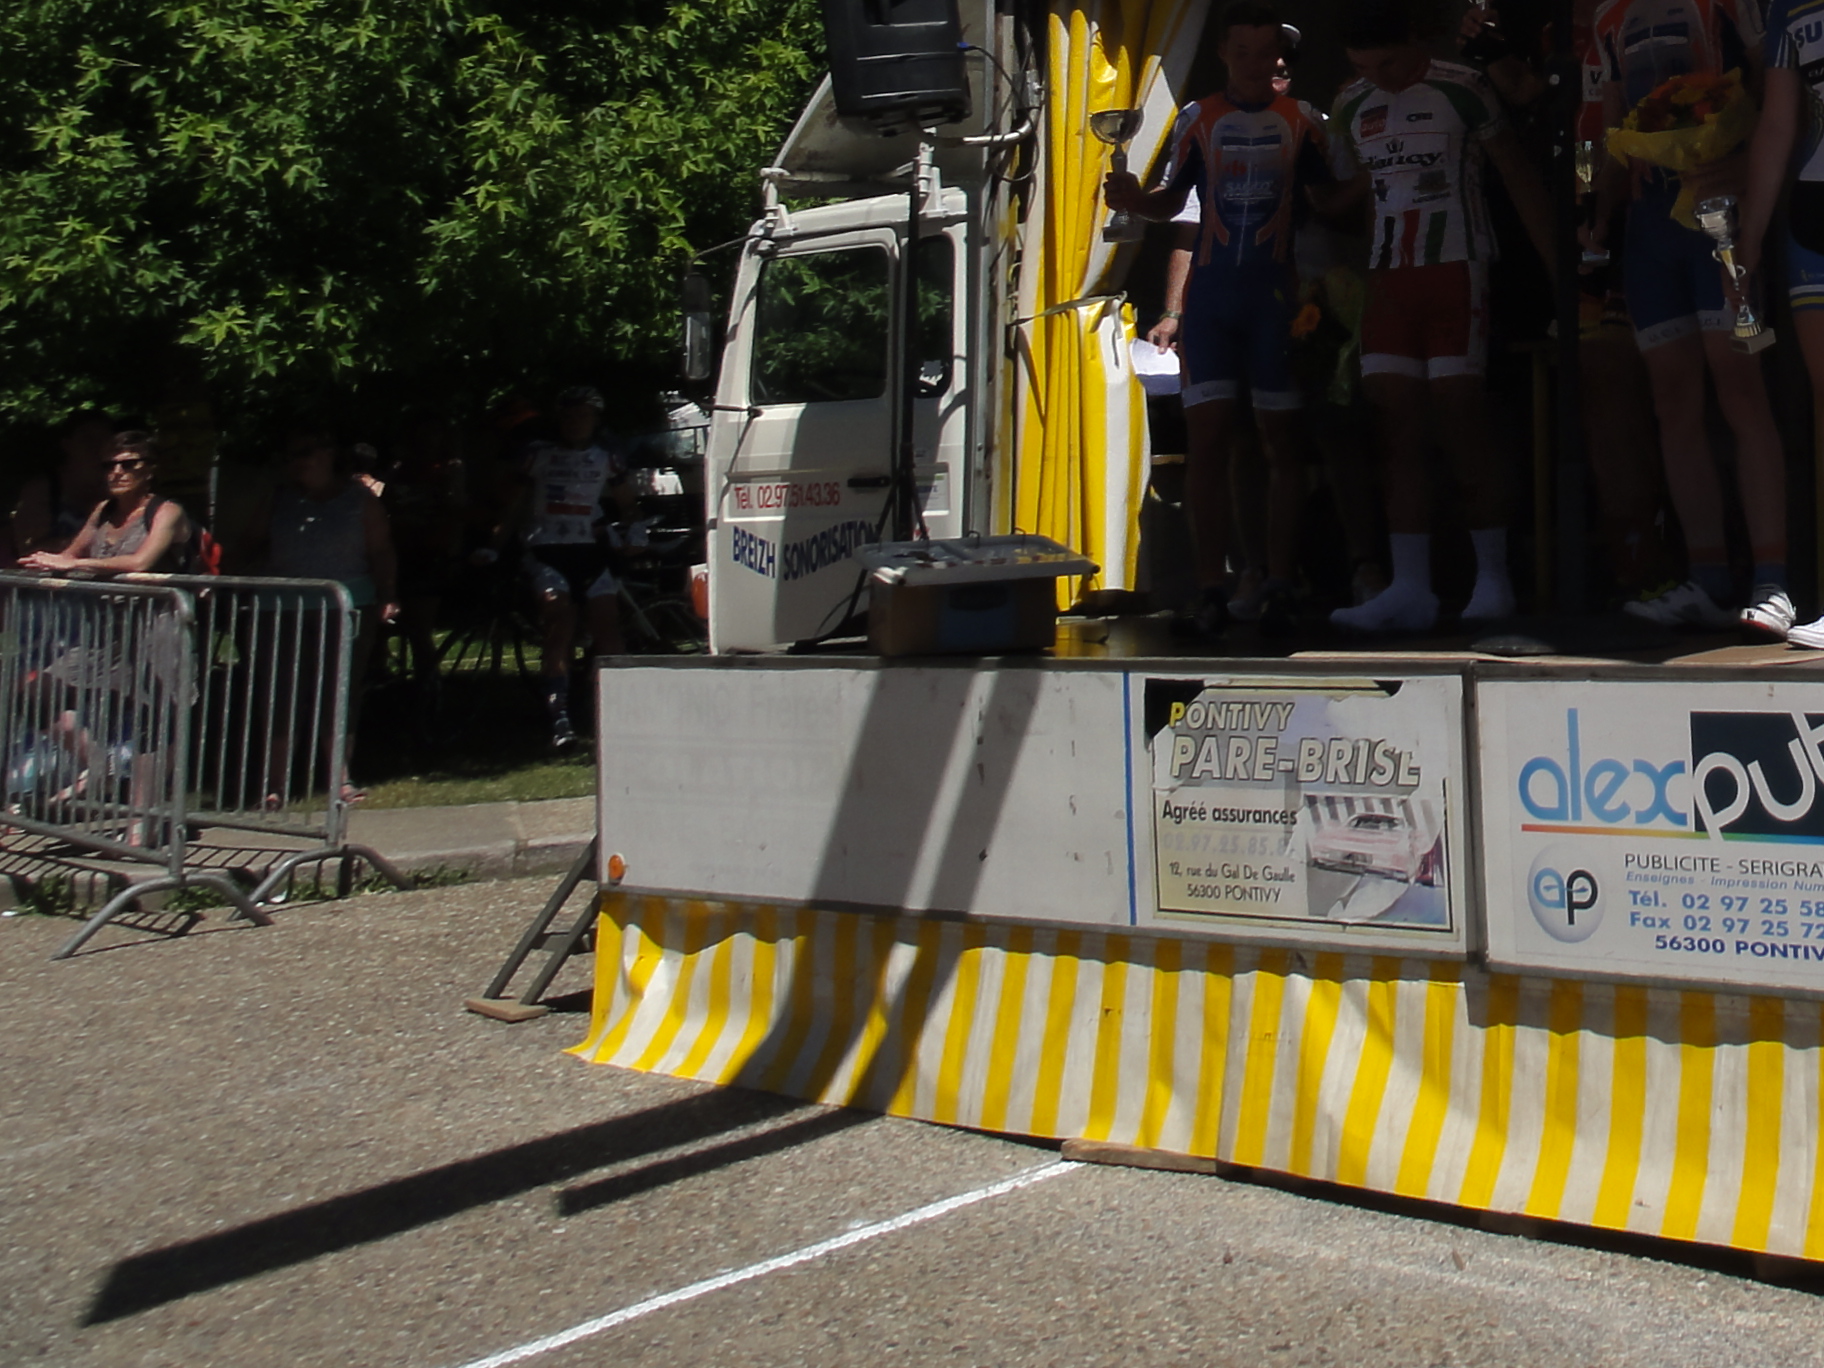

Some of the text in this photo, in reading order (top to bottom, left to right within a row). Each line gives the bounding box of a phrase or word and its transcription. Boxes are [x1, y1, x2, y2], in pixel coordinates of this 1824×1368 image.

[733, 526, 775, 578] BREIZH
[1169, 701, 1295, 732] PONTIVY
[1170, 735, 1422, 787] PARE-BRISE
[1162, 799, 1298, 826] Agréé assurances
[1187, 867, 1201, 877] rue
[1205, 863, 1218, 877] du
[1244, 865, 1259, 881] De
[1625, 853, 1720, 873] PUBLICITE
[1187, 883, 1281, 903] 56300 PONTIVY
[1626, 870, 1695, 886] Enseignes
[1710, 875, 1788, 891] Impression
[1628, 890, 1667, 908] Tél.
[1682, 893, 1710, 911] 02
[1720, 895, 1750, 913] 97
[1760, 897, 1788, 915] 25
[1629, 911, 1671, 929] Fax
[1683, 914, 1711, 932] 02
[1721, 916, 1751, 935] 97
[1761, 919, 1789, 937] 25
[1655, 934, 1726, 955] 56300
